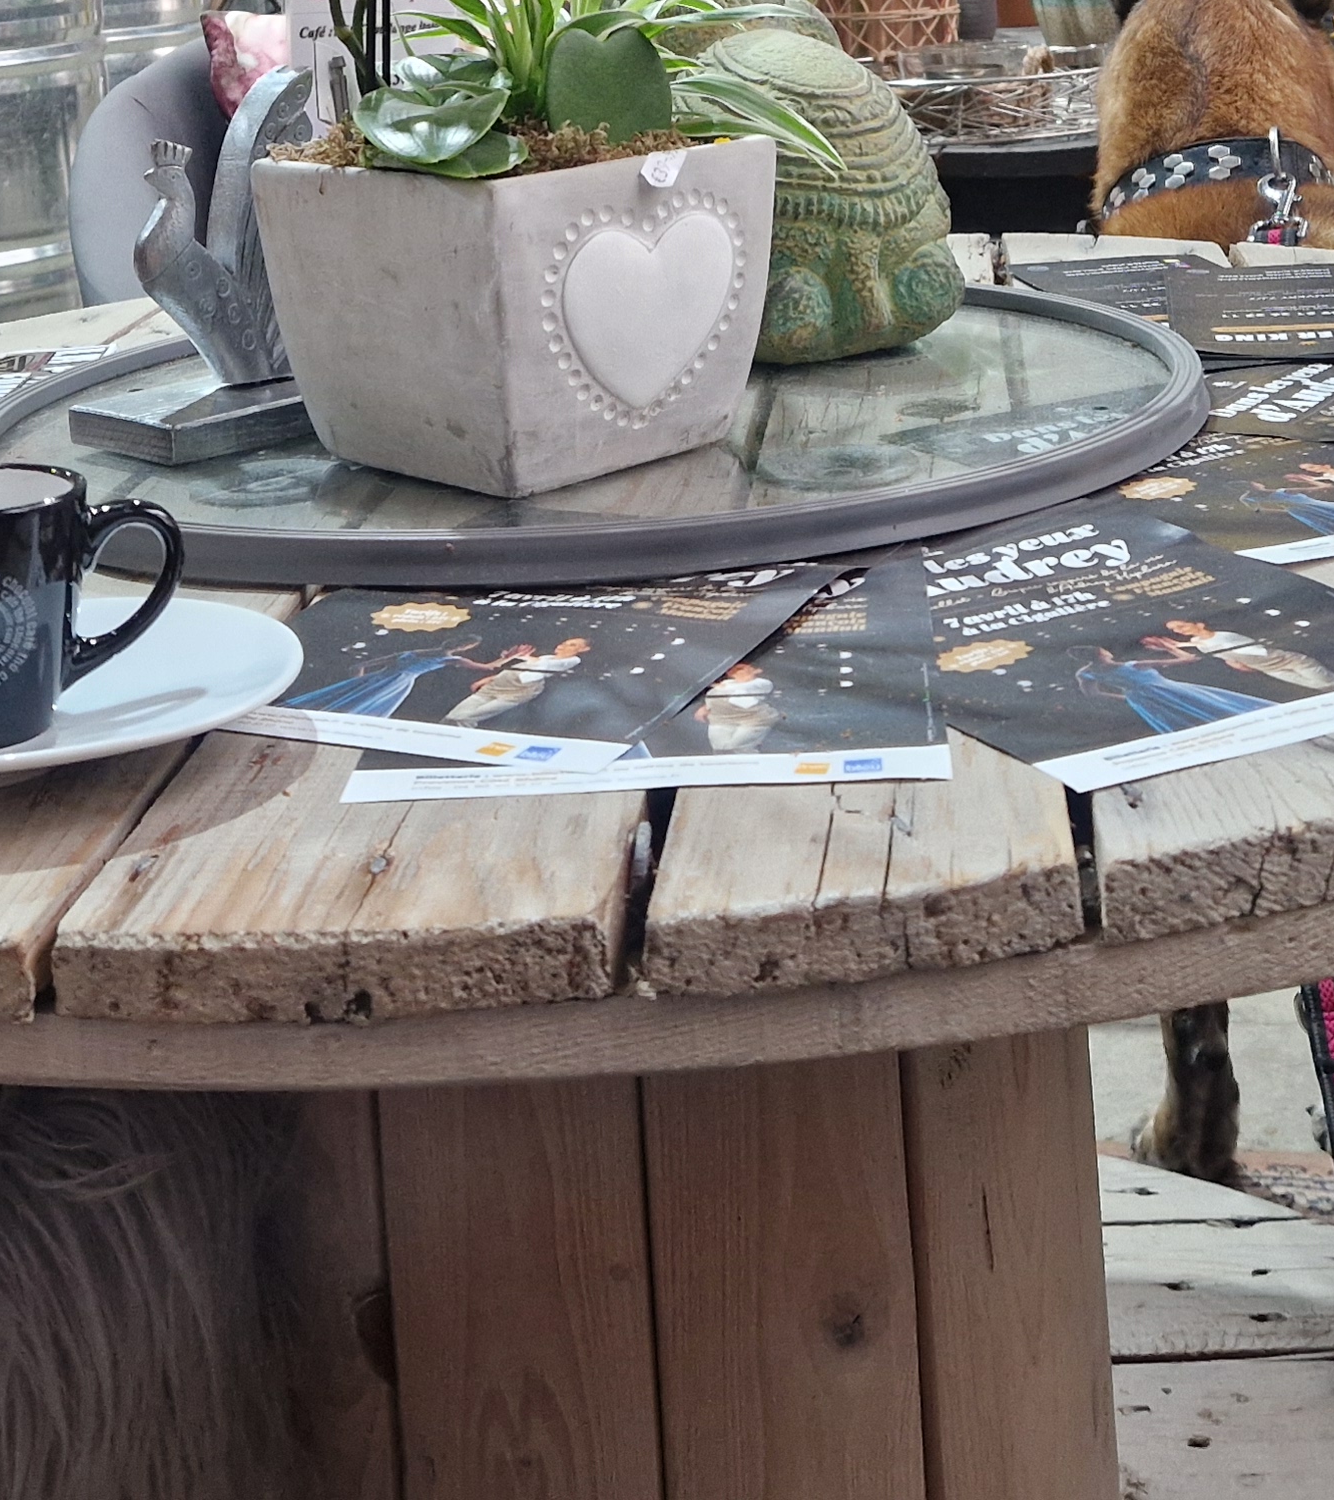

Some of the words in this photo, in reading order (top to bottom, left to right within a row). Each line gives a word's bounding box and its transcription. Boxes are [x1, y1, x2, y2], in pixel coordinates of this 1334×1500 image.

[1213, 332, 1289, 342] KING
[982, 420, 1078, 443] Dans
[923, 550, 992, 575] les
[992, 523, 1100, 561] yeux
[943, 617, 963, 629] 7
[963, 601, 1029, 626] avril
[1053, 591, 1097, 608] 17h
[979, 620, 1009, 632] la
[1008, 598, 1112, 626] Cigalière
